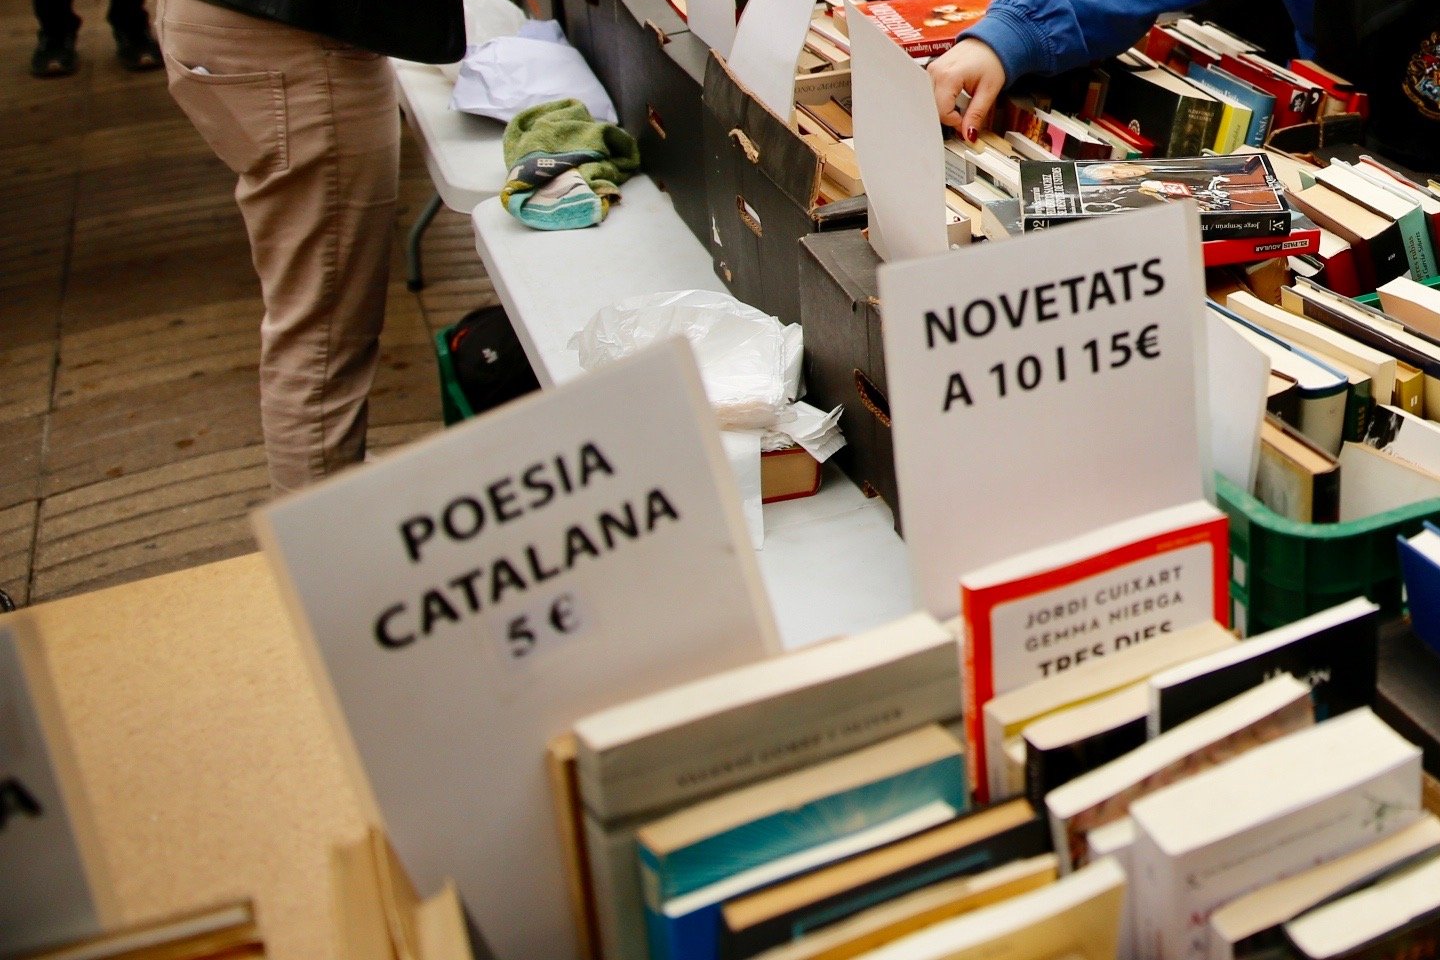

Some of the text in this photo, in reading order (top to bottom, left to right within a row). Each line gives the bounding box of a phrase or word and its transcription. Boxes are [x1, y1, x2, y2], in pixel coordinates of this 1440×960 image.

[1215, 222, 1243, 231] Semprún
[1243, 221, 1260, 230] Jorge
[1255, 243, 1282, 252] AGUILAR
[1408, 235, 1418, 261] rubias
[925, 258, 1165, 349] NOVETATS
[942, 372, 973, 412] A
[989, 355, 1042, 397] 10
[1084, 324, 1161, 373] 15€
[398, 441, 615, 564] POESIA
[373, 487, 682, 650] CATALANA
[1025, 566, 1183, 629] JORDI CUIXART
[506, 593, 582, 658] 5 €
[1025, 591, 1184, 652] GEMMA NIERGA
